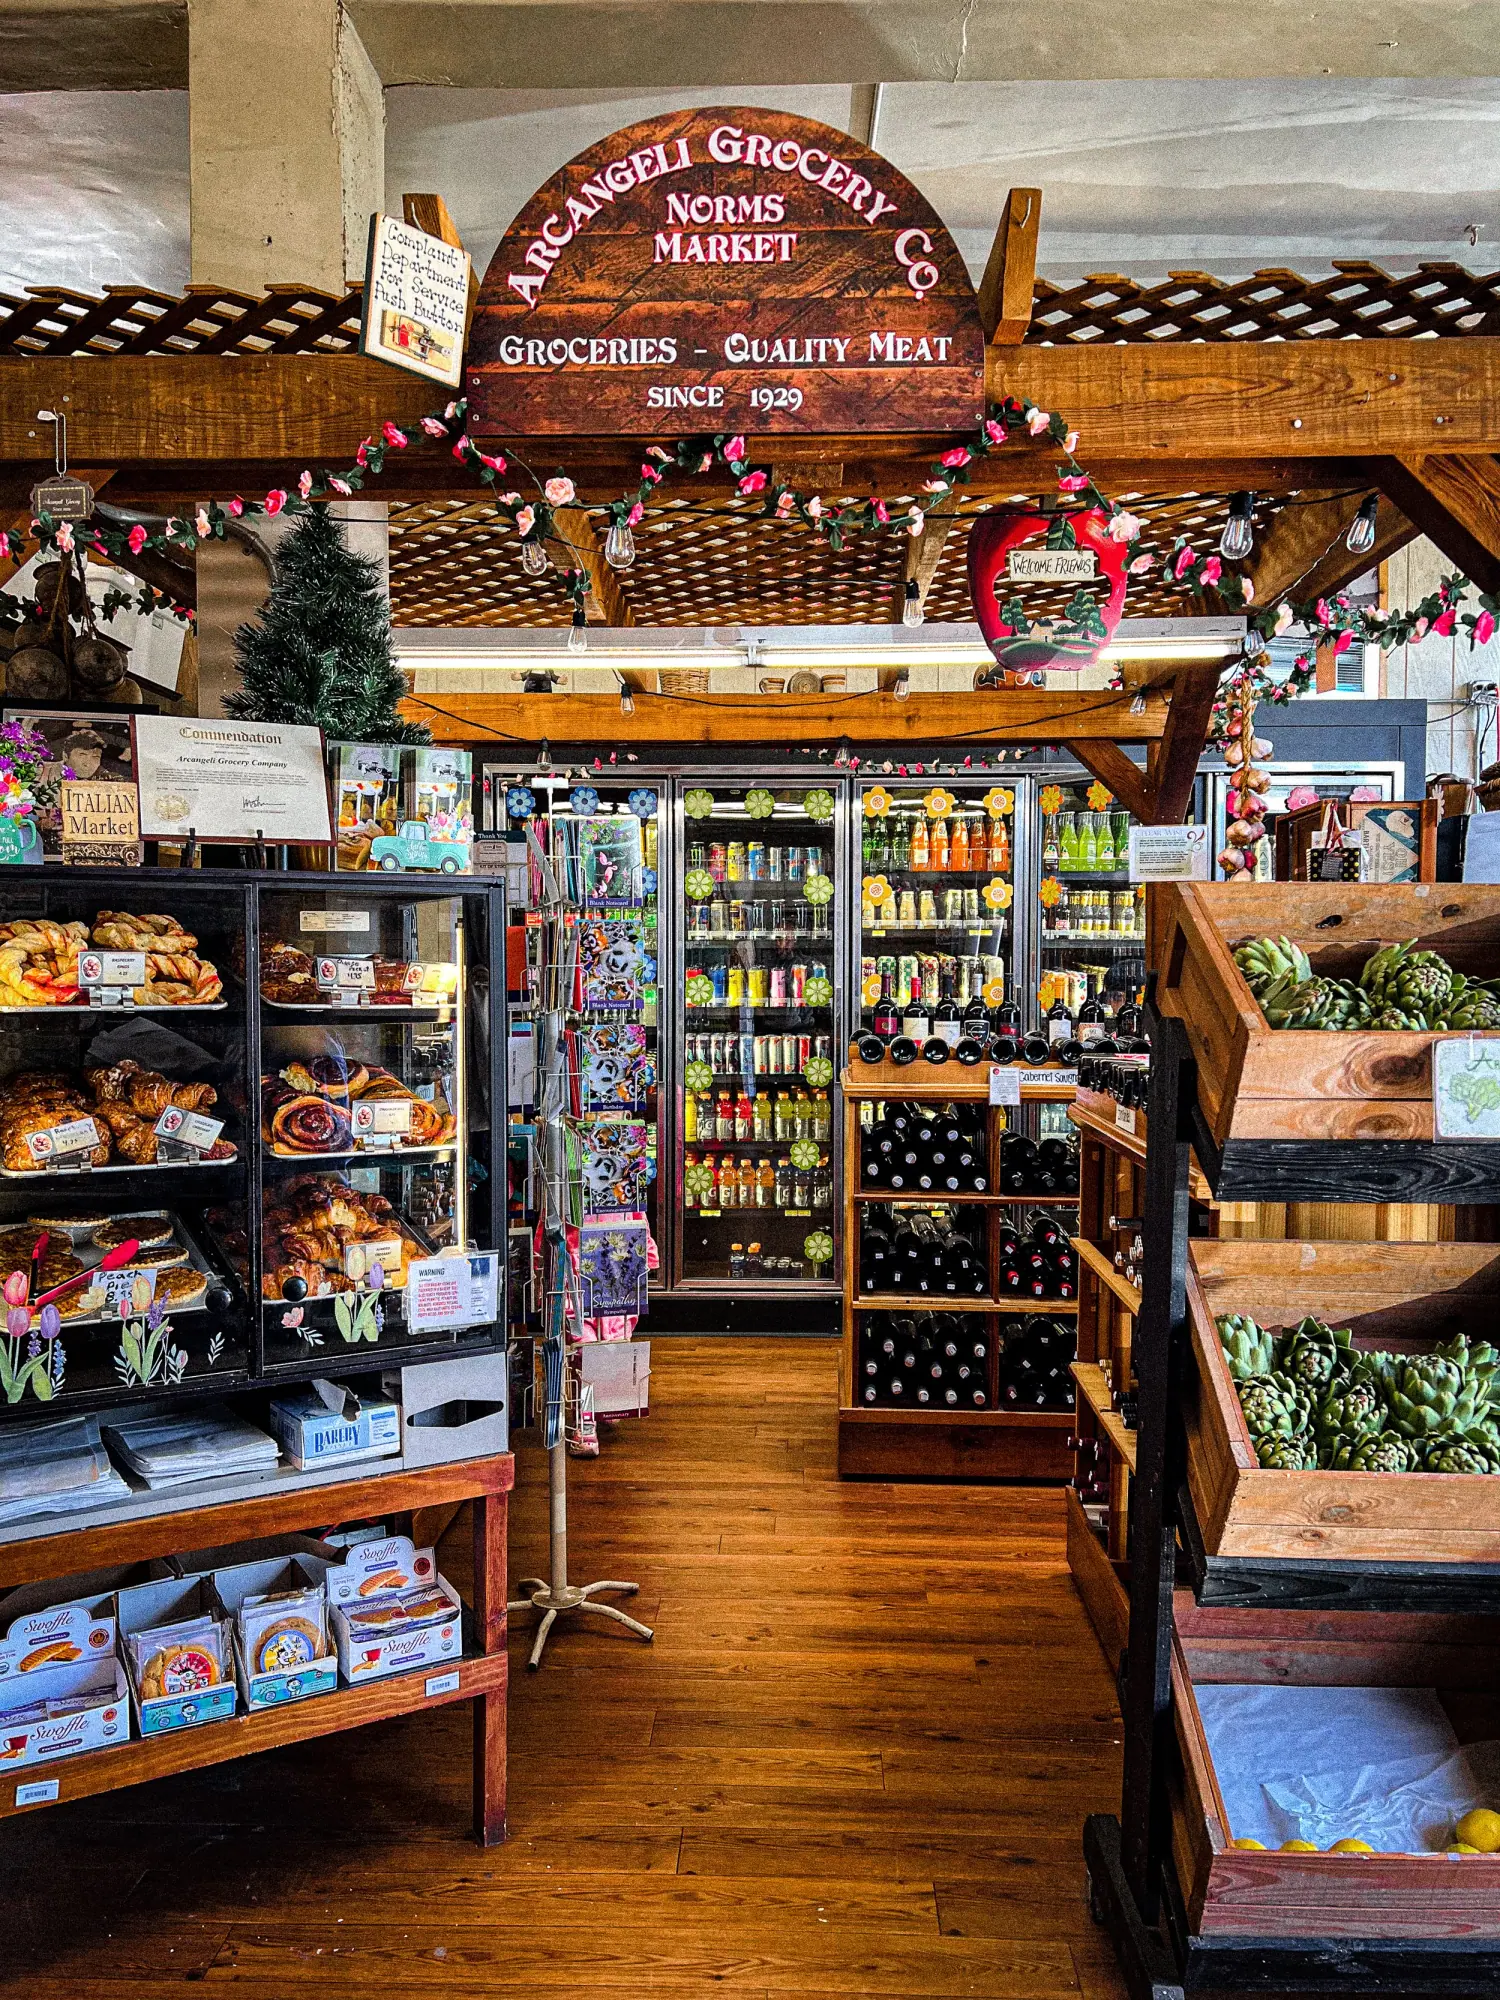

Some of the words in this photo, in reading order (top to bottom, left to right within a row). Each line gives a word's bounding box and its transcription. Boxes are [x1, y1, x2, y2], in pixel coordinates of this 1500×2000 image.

[508, 136, 695, 310] ARCANGELI
[708, 124, 899, 226] GROCERY
[666, 193, 786, 226] NORMS
[388, 223, 459, 268] Complaint
[653, 232, 798, 265] MARKET
[381, 241, 466, 293] Department
[380, 261, 402, 287] For
[411, 275, 464, 315] Service
[375, 280, 407, 311] Push
[414, 297, 463, 334] Button
[499, 335, 678, 366] GROCERIES
[723, 333, 850, 366] QUALITY
[868, 331, 953, 363] MEAT
[646, 386, 725, 409] SINCE
[750, 387, 803, 412] 1929
[1013, 555, 1052, 575] WELCOME
[1054, 556, 1092, 574] FRIENDS
[179, 726, 283, 745] Commendation
[176, 755, 217, 765] Arcangeli
[217, 757, 251, 768] Grocery
[251, 758, 288, 769] Company
[65, 788, 135, 814] ITALIAN
[69, 815, 134, 835] Market
[1020, 1072, 1053, 1083] Cabernet
[418, 1267, 445, 1277] WARNING
[593, 1294, 636, 1308] Sympathy
[314, 1424, 360, 1453] BAKERY
[360, 1541, 400, 1561] Swoffle
[23, 1610, 76, 1634] Swoffle
[383, 1631, 431, 1654] Swoffle
[30, 1714, 90, 1741] Swoffle
